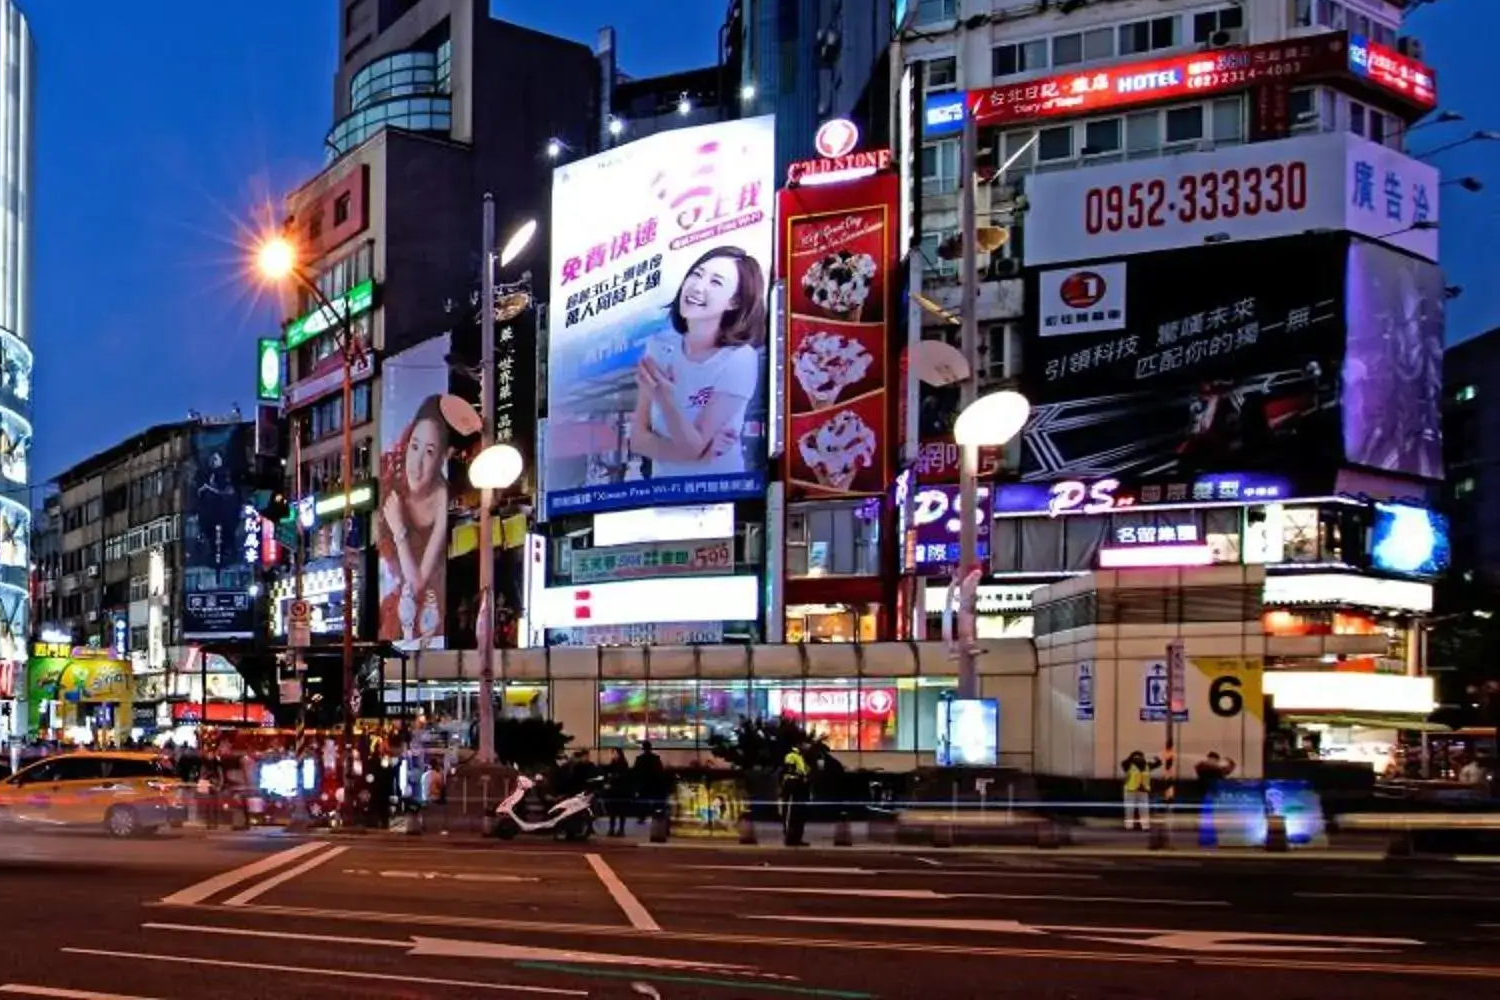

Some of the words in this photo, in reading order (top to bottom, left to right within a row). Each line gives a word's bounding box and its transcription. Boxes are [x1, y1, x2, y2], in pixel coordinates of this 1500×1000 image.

[1117, 71, 1179, 93] HOTEL
[788, 159, 831, 182] COLD
[834, 150, 891, 170] STONE
[1352, 160, 1431, 223] 廣告洽
[560, 216, 658, 287] 免費快速
[1209, 675, 1243, 717] 6
